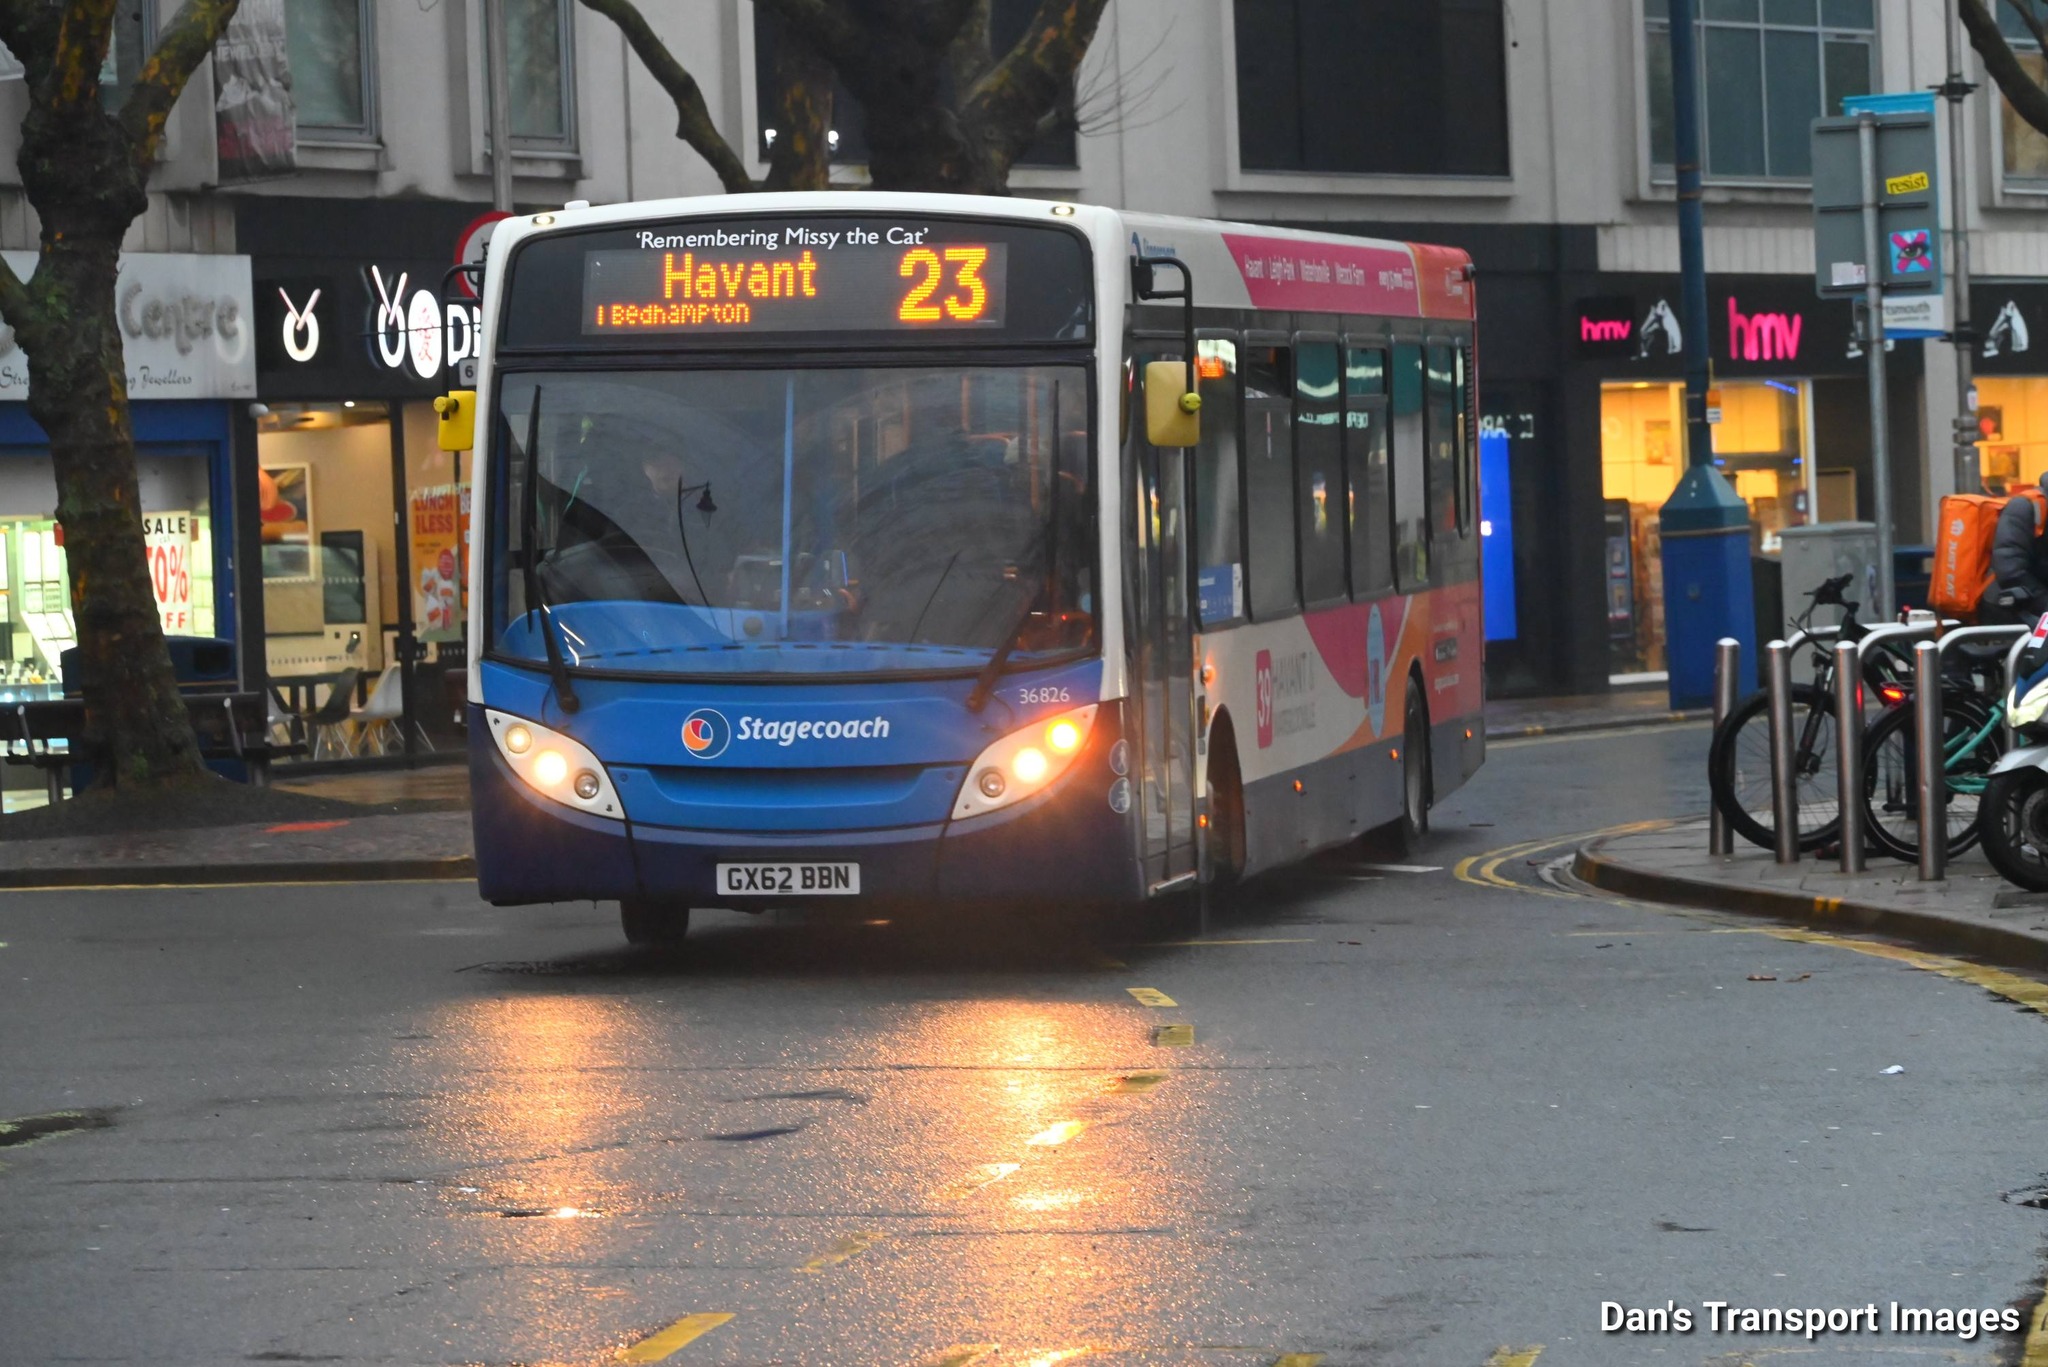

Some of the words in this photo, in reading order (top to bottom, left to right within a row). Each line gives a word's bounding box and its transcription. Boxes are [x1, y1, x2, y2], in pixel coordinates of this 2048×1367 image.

[1889, 174, 1927, 193] resist
[785, 227, 840, 249] Missy
[846, 227, 879, 245] the
[664, 251, 817, 298] Havant
[898, 247, 987, 320] 23
[119, 282, 239, 357] Centre
[612, 303, 749, 325] Bedhampton
[1581, 316, 1632, 341] hmv
[1728, 296, 1802, 361] hmv
[139, 366, 192, 391] Jewellers
[144, 517, 186, 535] SALE
[1019, 686, 1070, 704] 36826
[1258, 668, 1271, 728] 39
[737, 715, 889, 746] Stagecoach
[727, 866, 793, 891] GX62
[801, 866, 849, 889] BBN
